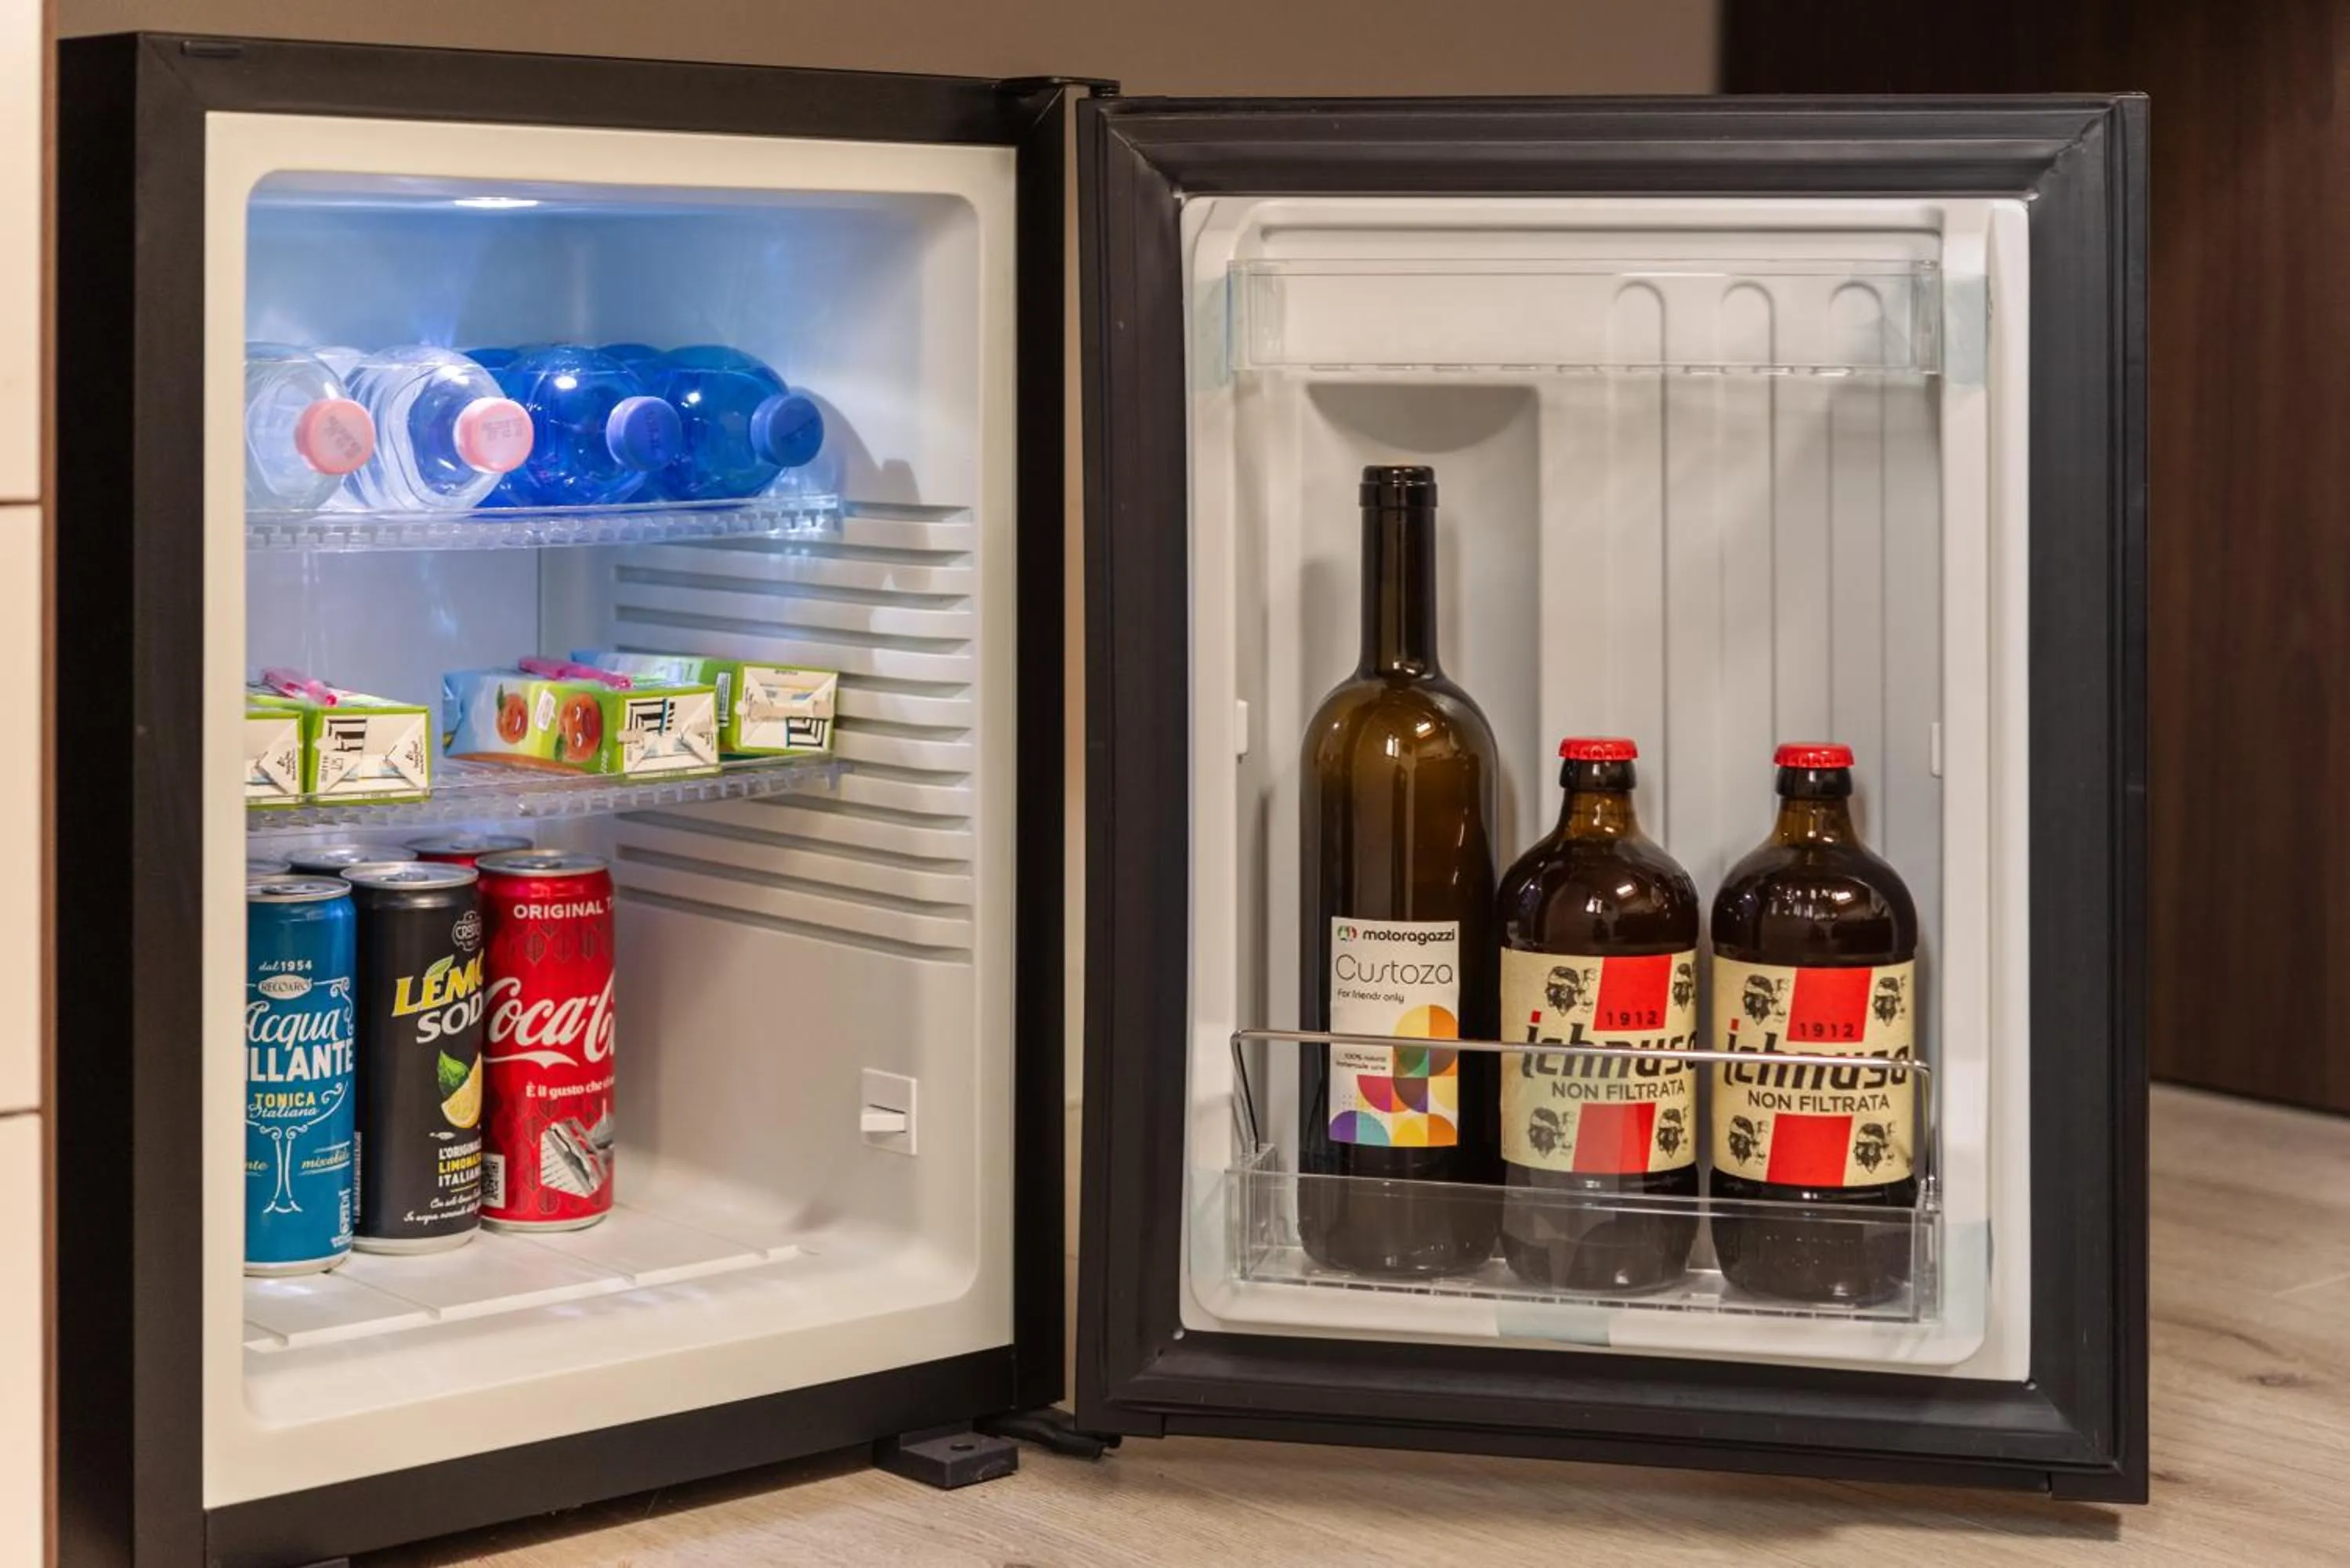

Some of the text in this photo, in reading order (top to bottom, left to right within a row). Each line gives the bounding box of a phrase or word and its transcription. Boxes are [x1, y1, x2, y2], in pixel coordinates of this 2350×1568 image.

[513, 900, 604, 919] ORIGINAL
[1363, 929, 1455, 945] motoragazzi
[280, 959, 313, 972] 1954
[1336, 954, 1453, 984] Custoza
[1383, 992, 1405, 1004] only
[1607, 1010, 1658, 1026] 1912
[1800, 1022, 1854, 1038] 1912
[548, 1084, 585, 1100] gusto
[585, 1078, 602, 1093] che
[1552, 1078, 1685, 1100] NON FILTRATA
[254, 1092, 316, 1108] TONICA
[1748, 1089, 1890, 1112] NON FILTRATA
